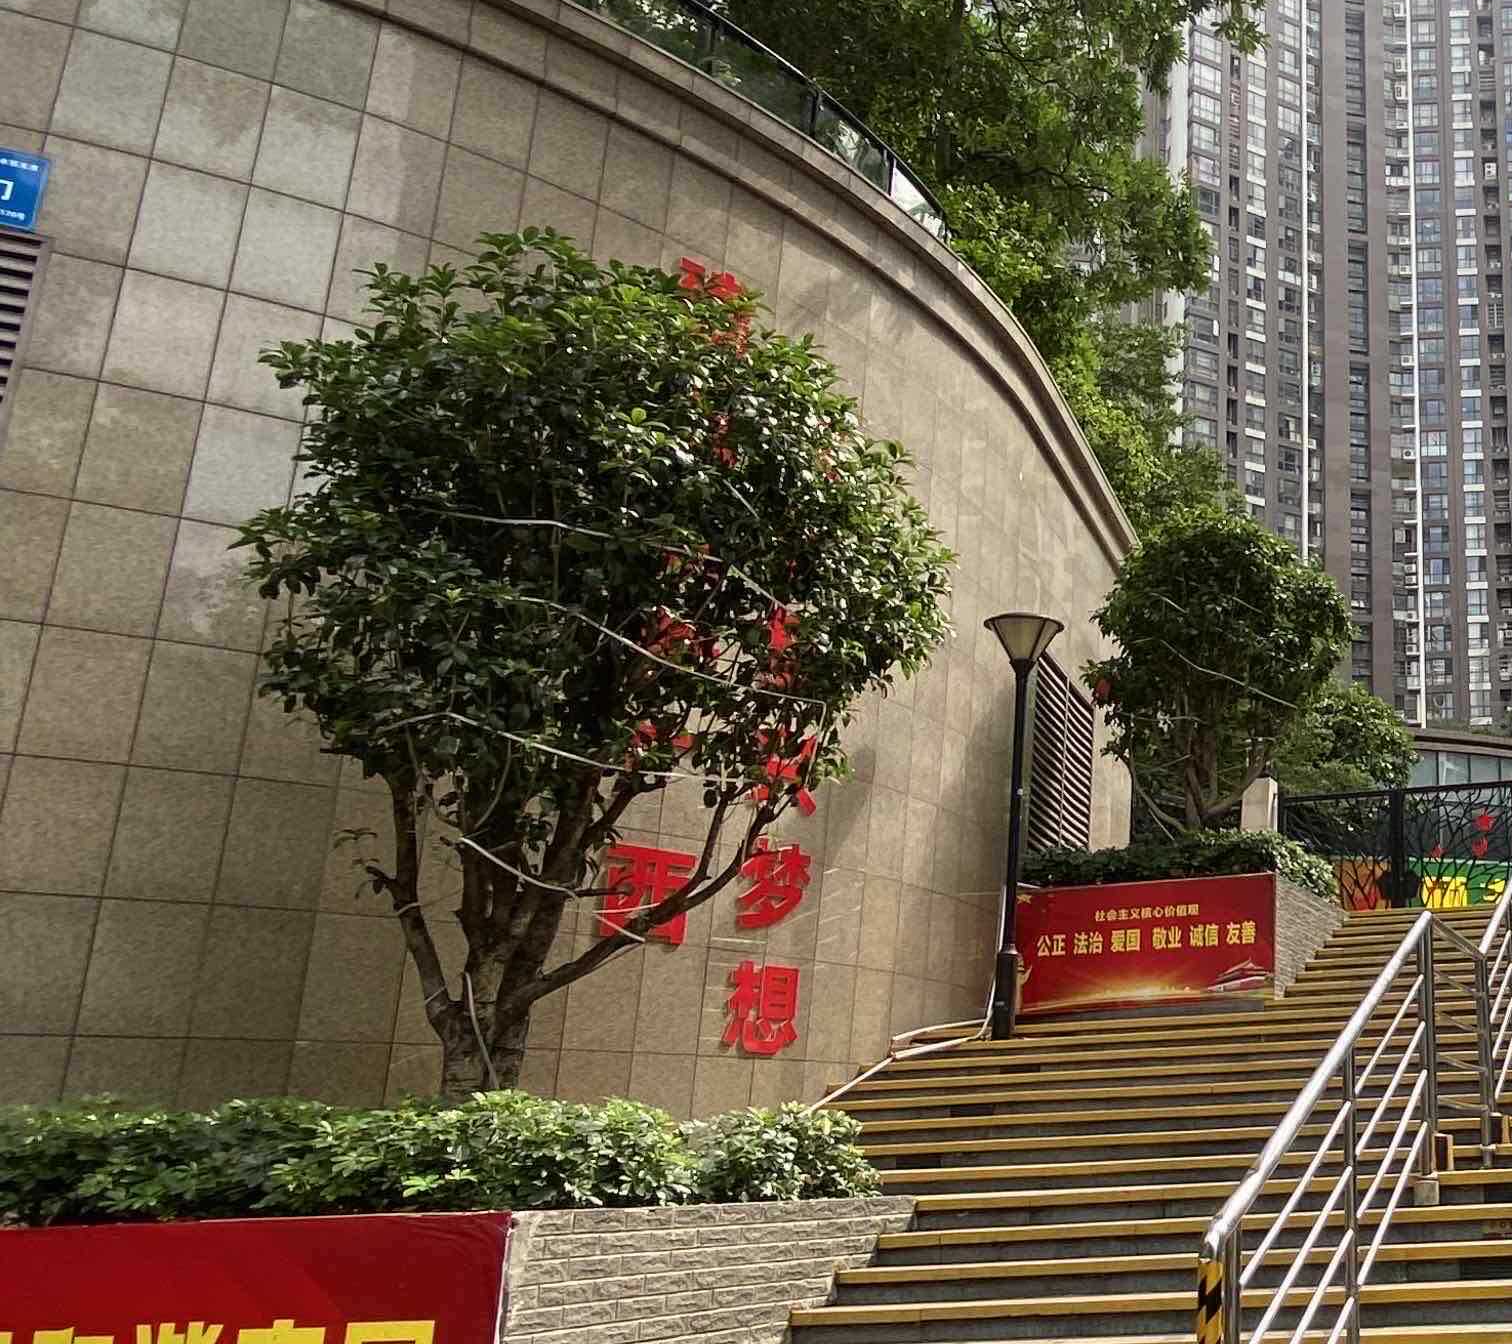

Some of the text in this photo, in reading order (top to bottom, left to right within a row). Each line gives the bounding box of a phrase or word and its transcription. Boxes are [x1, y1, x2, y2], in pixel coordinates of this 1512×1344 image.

[1095, 903, 1199, 922] 社会主义核心价值观
[1037, 919, 1256, 957] 公正 法治 爱国 敬业 诚信 友善
